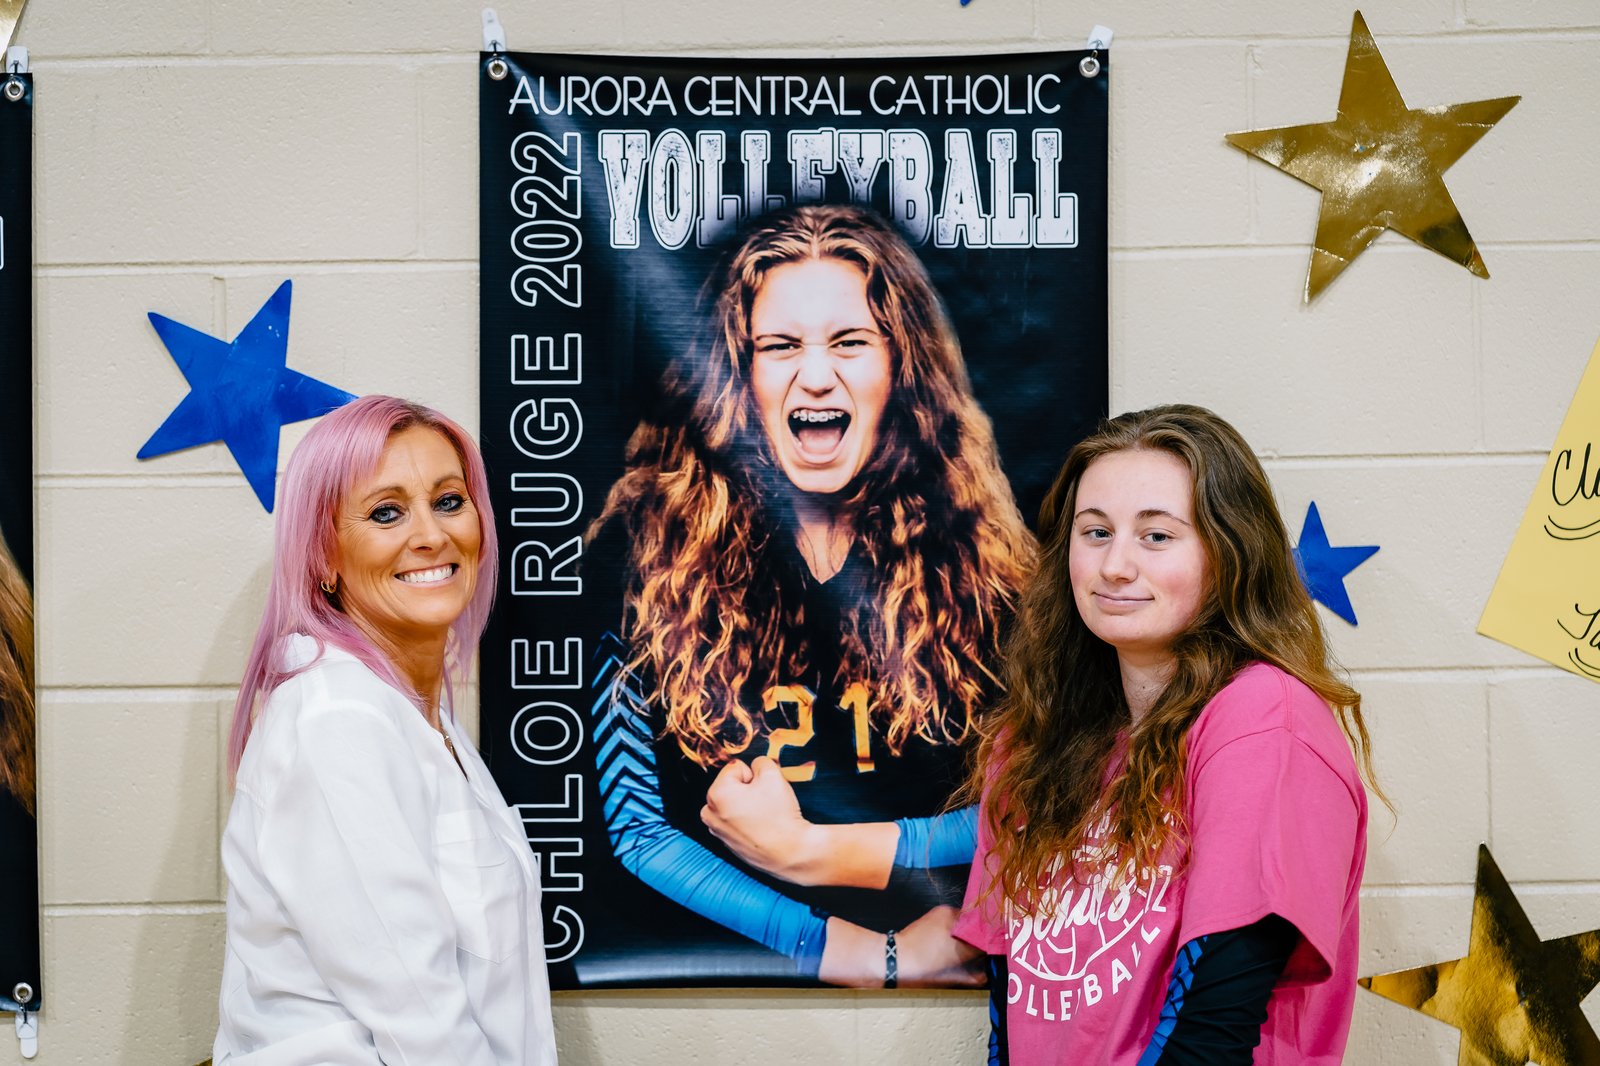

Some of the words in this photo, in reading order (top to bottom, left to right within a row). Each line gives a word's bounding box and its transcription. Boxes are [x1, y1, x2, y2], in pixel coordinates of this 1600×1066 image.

[508, 75, 677, 117] AURORA
[684, 74, 862, 116] CENTRAL
[869, 73, 1062, 115] CATHOLIC
[510, 131, 582, 308] 2022
[597, 127, 1079, 250] VOLLEYBALL
[510, 333, 583, 596] RUGE
[761, 682, 876, 783] 21
